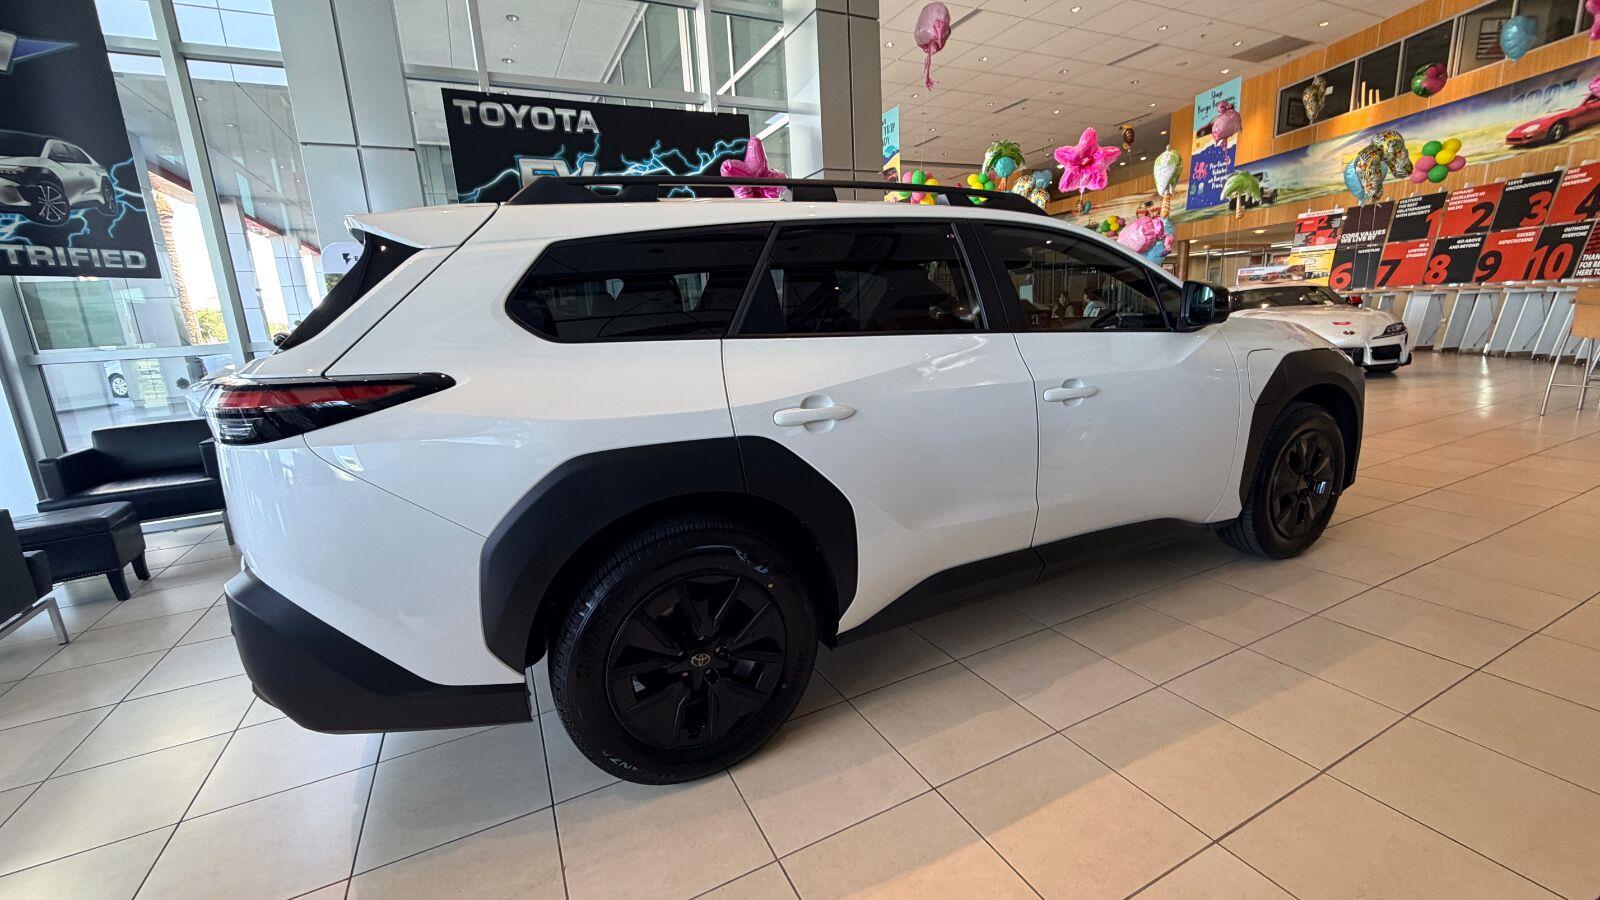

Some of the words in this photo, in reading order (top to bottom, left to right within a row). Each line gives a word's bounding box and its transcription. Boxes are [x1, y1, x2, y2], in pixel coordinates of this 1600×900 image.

[452, 99, 600, 134] TOYOTA
[1505, 179, 1553, 191] UNCONDITIONALLY
[1562, 177, 1592, 187] OWNERSHIP
[1564, 172, 1587, 180] EXTREME
[1397, 205, 1431, 213] RELATIONSHIPS
[1449, 198, 1478, 206] EVERYTHING
[1451, 193, 1480, 201] EXCELLENCE
[1519, 191, 1552, 226] 3
[1574, 182, 1600, 218] 4
[1426, 207, 1443, 239] 1
[1464, 202, 1494, 233] 2
[1341, 231, 1359, 239] CORE
[1360, 229, 1386, 238] VALUES
[1498, 237, 1533, 245] EXPECTATIONS
[0, 244, 147, 269] TRIFIED
[1424, 254, 1451, 285] 8
[1475, 250, 1502, 283] 9
[1527, 243, 1574, 280] 10
[1329, 261, 1352, 289] 6
[1377, 258, 1402, 287] 7
[1576, 269, 1593, 277] HERE
